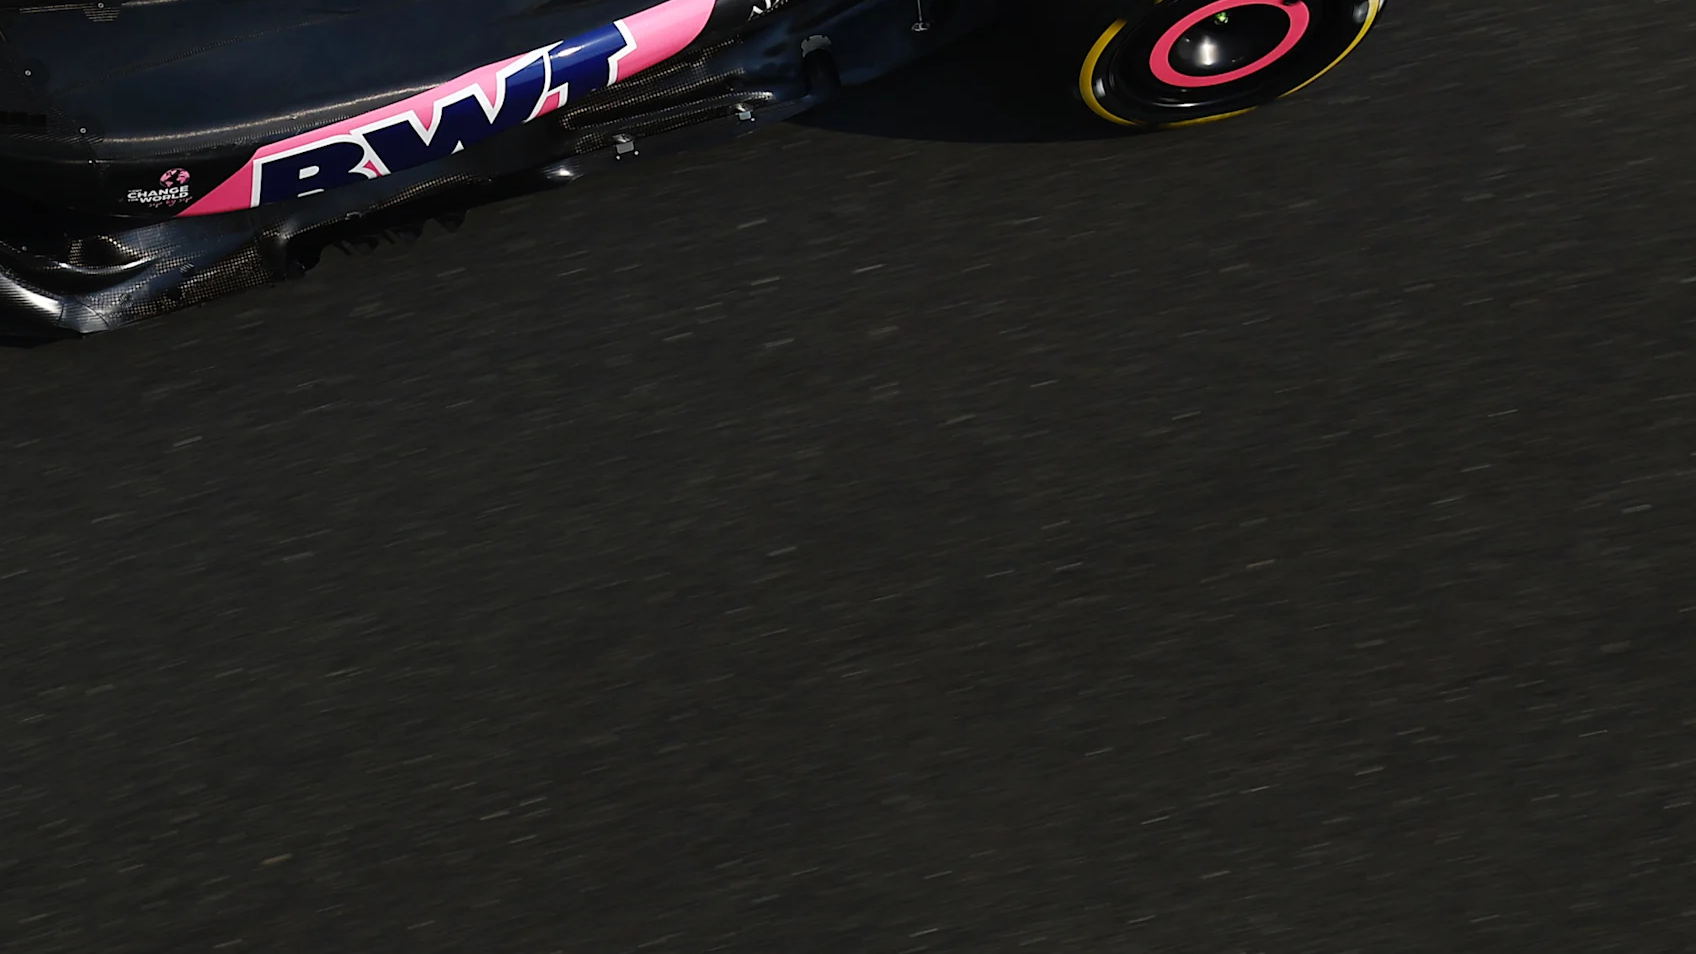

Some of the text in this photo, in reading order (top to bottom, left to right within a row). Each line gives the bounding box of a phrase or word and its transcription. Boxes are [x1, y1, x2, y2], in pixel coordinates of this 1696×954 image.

[251, 20, 637, 208] BWT
[127, 185, 189, 201] CHANGE
[141, 193, 189, 205] WORLD
